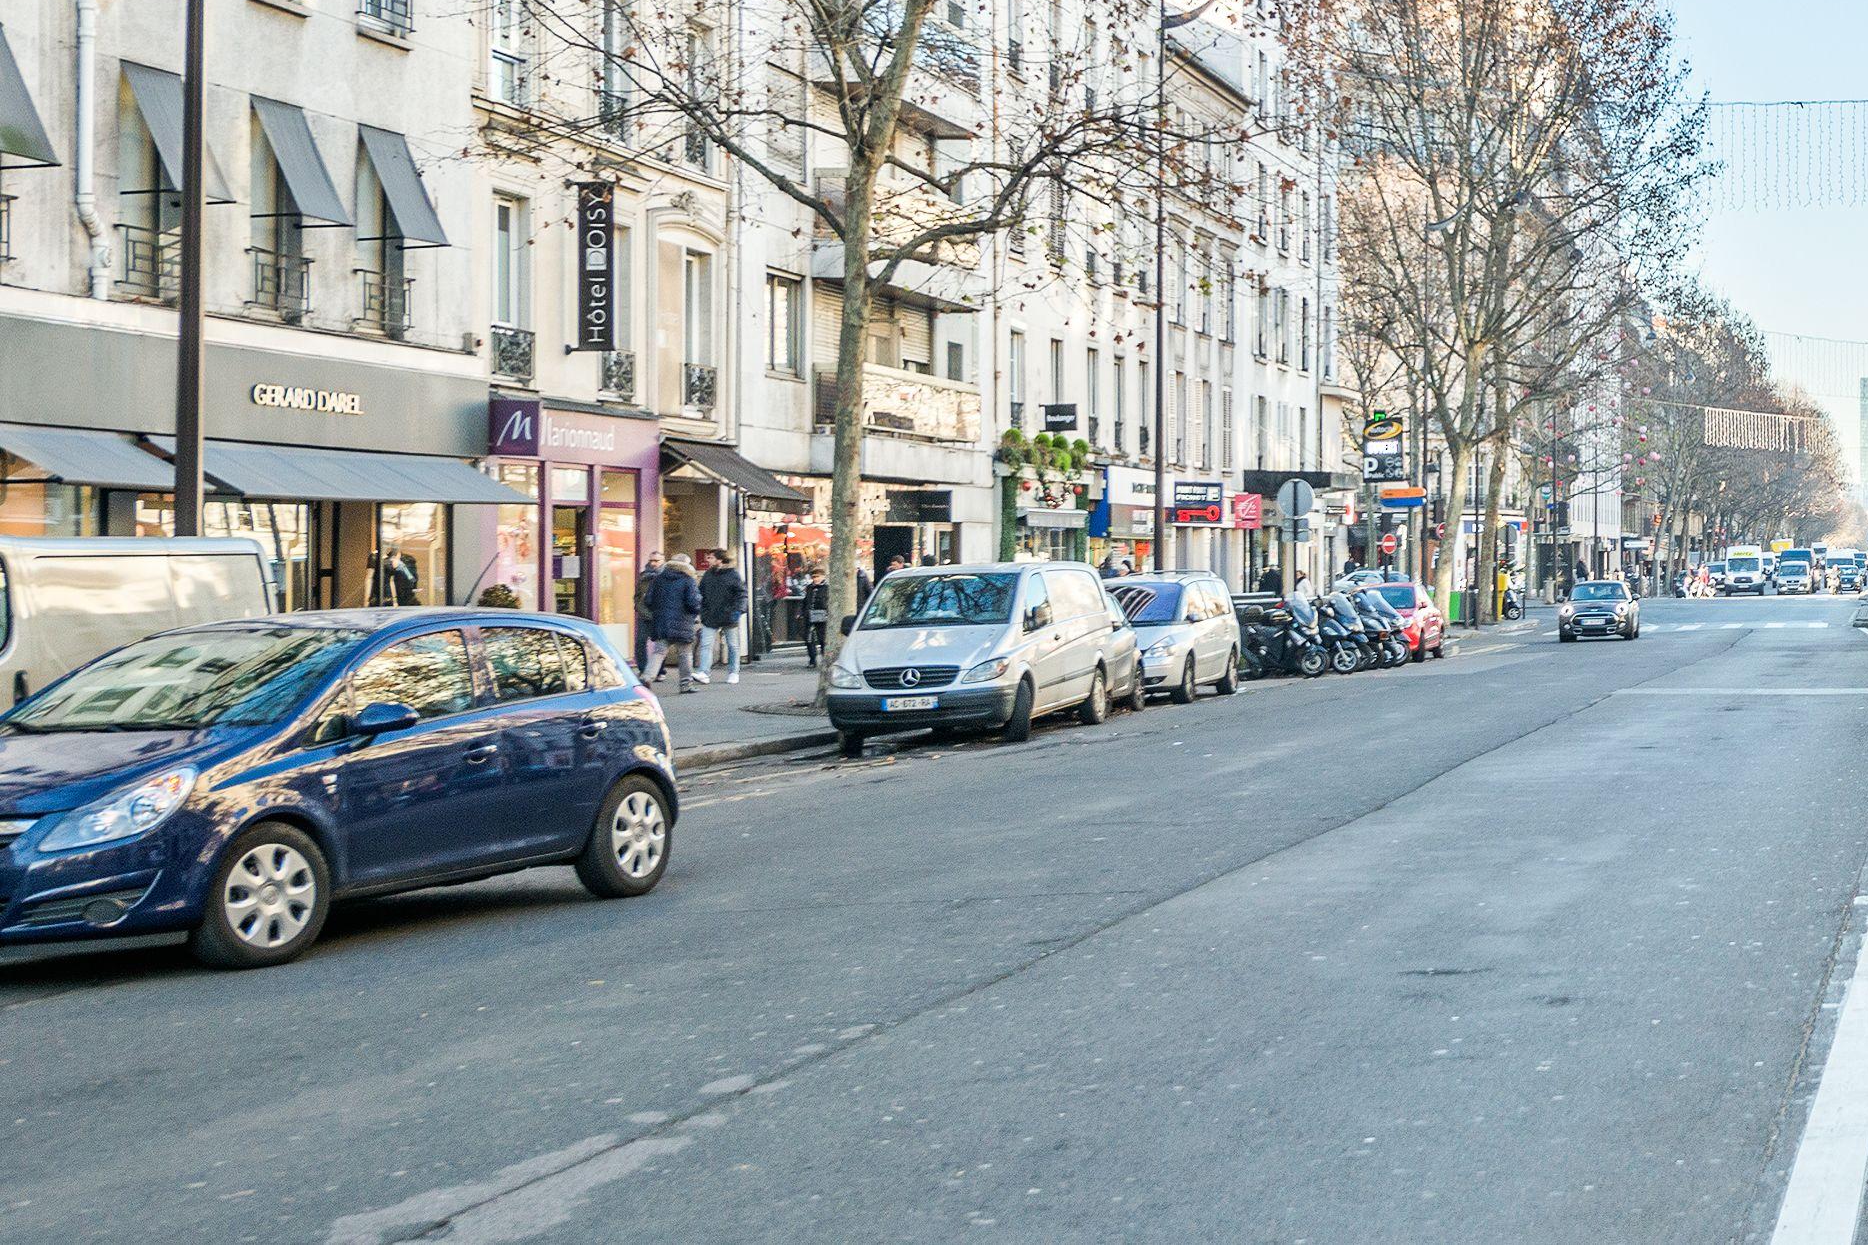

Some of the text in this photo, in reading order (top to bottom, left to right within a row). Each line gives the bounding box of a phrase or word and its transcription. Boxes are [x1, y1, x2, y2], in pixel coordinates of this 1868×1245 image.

[586, 192, 607, 343] Hôtel DOISY
[252, 383, 365, 415] GERARD DAREL
[541, 411, 615, 452] Marionnaud
